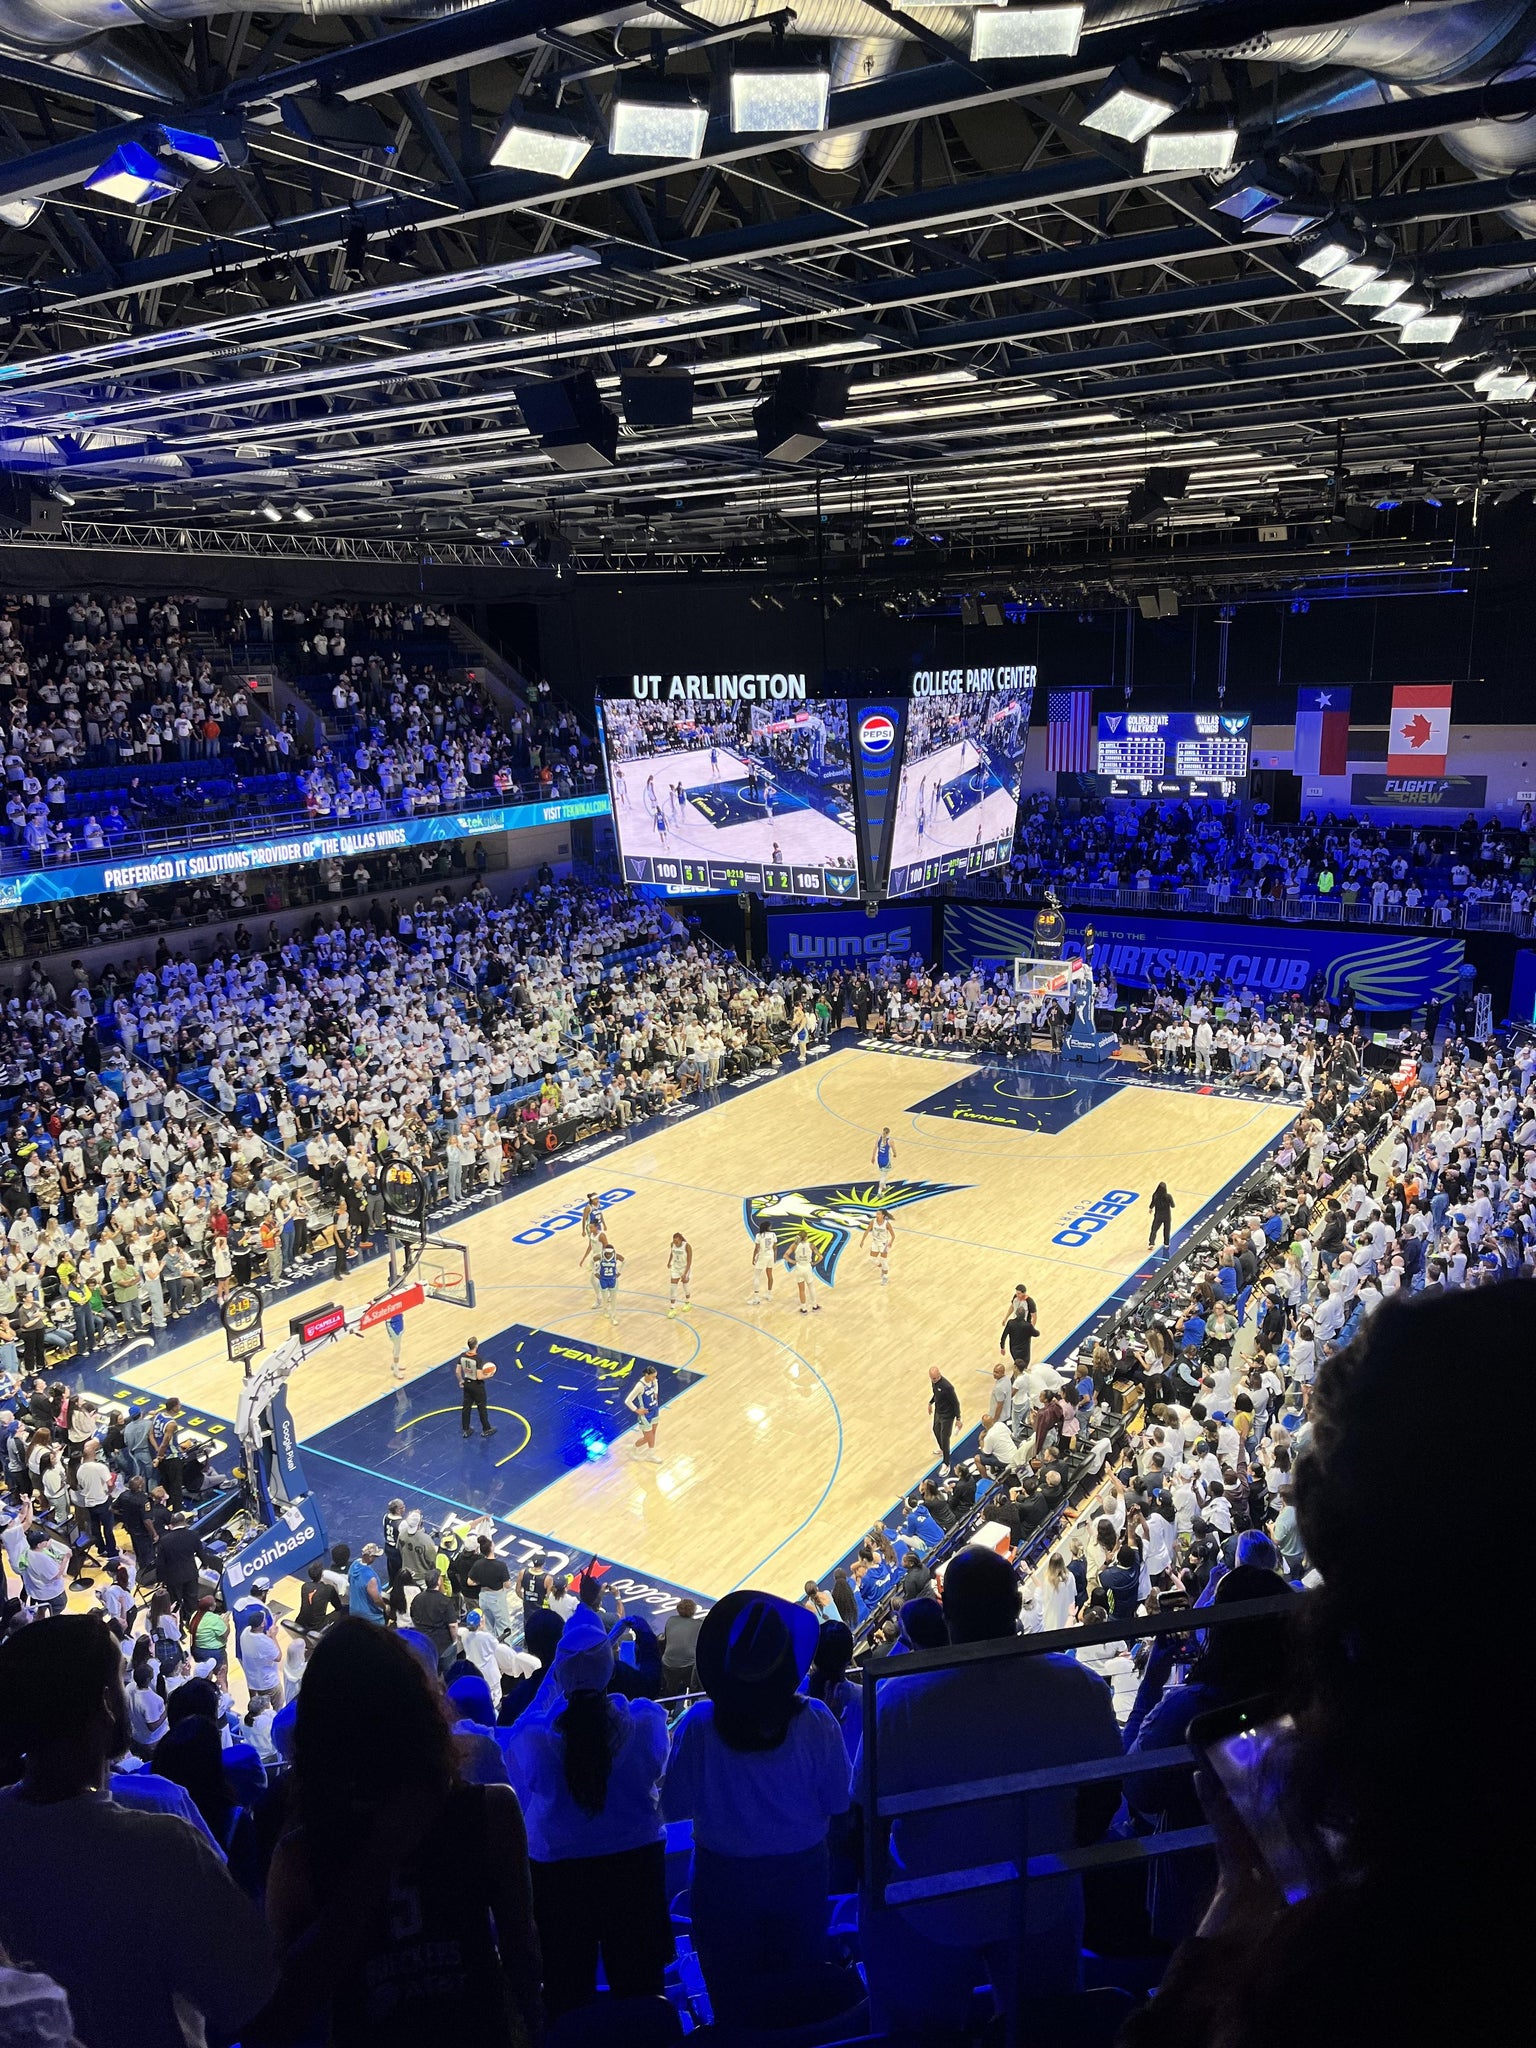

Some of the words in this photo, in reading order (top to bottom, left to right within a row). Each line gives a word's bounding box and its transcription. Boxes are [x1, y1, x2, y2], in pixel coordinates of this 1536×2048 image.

[633, 675, 662, 699] UT
[668, 674, 806, 699] ARLINGTON
[913, 669, 963, 697] COLLEGE
[966, 668, 995, 693] PARK
[997, 665, 1038, 689] CENTER
[1196, 715, 1220, 725] DALLAS
[863, 730, 892, 738] PEPSI
[1385, 780, 1437, 791] FLIGHT
[1399, 792, 1444, 804] CREW
[543, 806, 561, 821] VISIT
[104, 861, 174, 888] PREFERRED
[175, 860, 187, 877] IT
[189, 851, 250, 875] SOLUTIONS
[251, 843, 302, 867] PROVIDER
[302, 841, 316, 857] OF
[321, 838, 340, 855] THE
[340, 833, 376, 852] DALLAS
[376, 828, 406, 846] WINGS
[984, 847, 996, 862] 105
[656, 863, 678, 879] 100
[685, 869, 693, 881] 5
[697, 870, 705, 882] 1
[910, 867, 923, 884] 100
[767, 875, 774, 888] 1
[780, 876, 788, 888] 2
[796, 873, 820, 889] 105
[789, 926, 912, 959] WINGS
[1111, 931, 1124, 939] TO
[1125, 933, 1147, 941] THE
[1061, 941, 1224, 984] COURTSIDE
[1224, 955, 1311, 990] CLUB
[857, 1038, 977, 1059] WINGS
[963, 1112, 1018, 1125] WNBA
[1051, 1189, 1141, 1248] GEICO
[1053, 1199, 1093, 1228] COURT
[315, 1315, 341, 1330] CAPELLA
[549, 1344, 620, 1370] WNBA
[281, 1420, 292, 1451] Google
[286, 1451, 296, 1472] Pixel
[242, 1524, 316, 1578] coinbase
[529, 1579, 536, 1592] 5
[391, 1871, 424, 1938] 5
